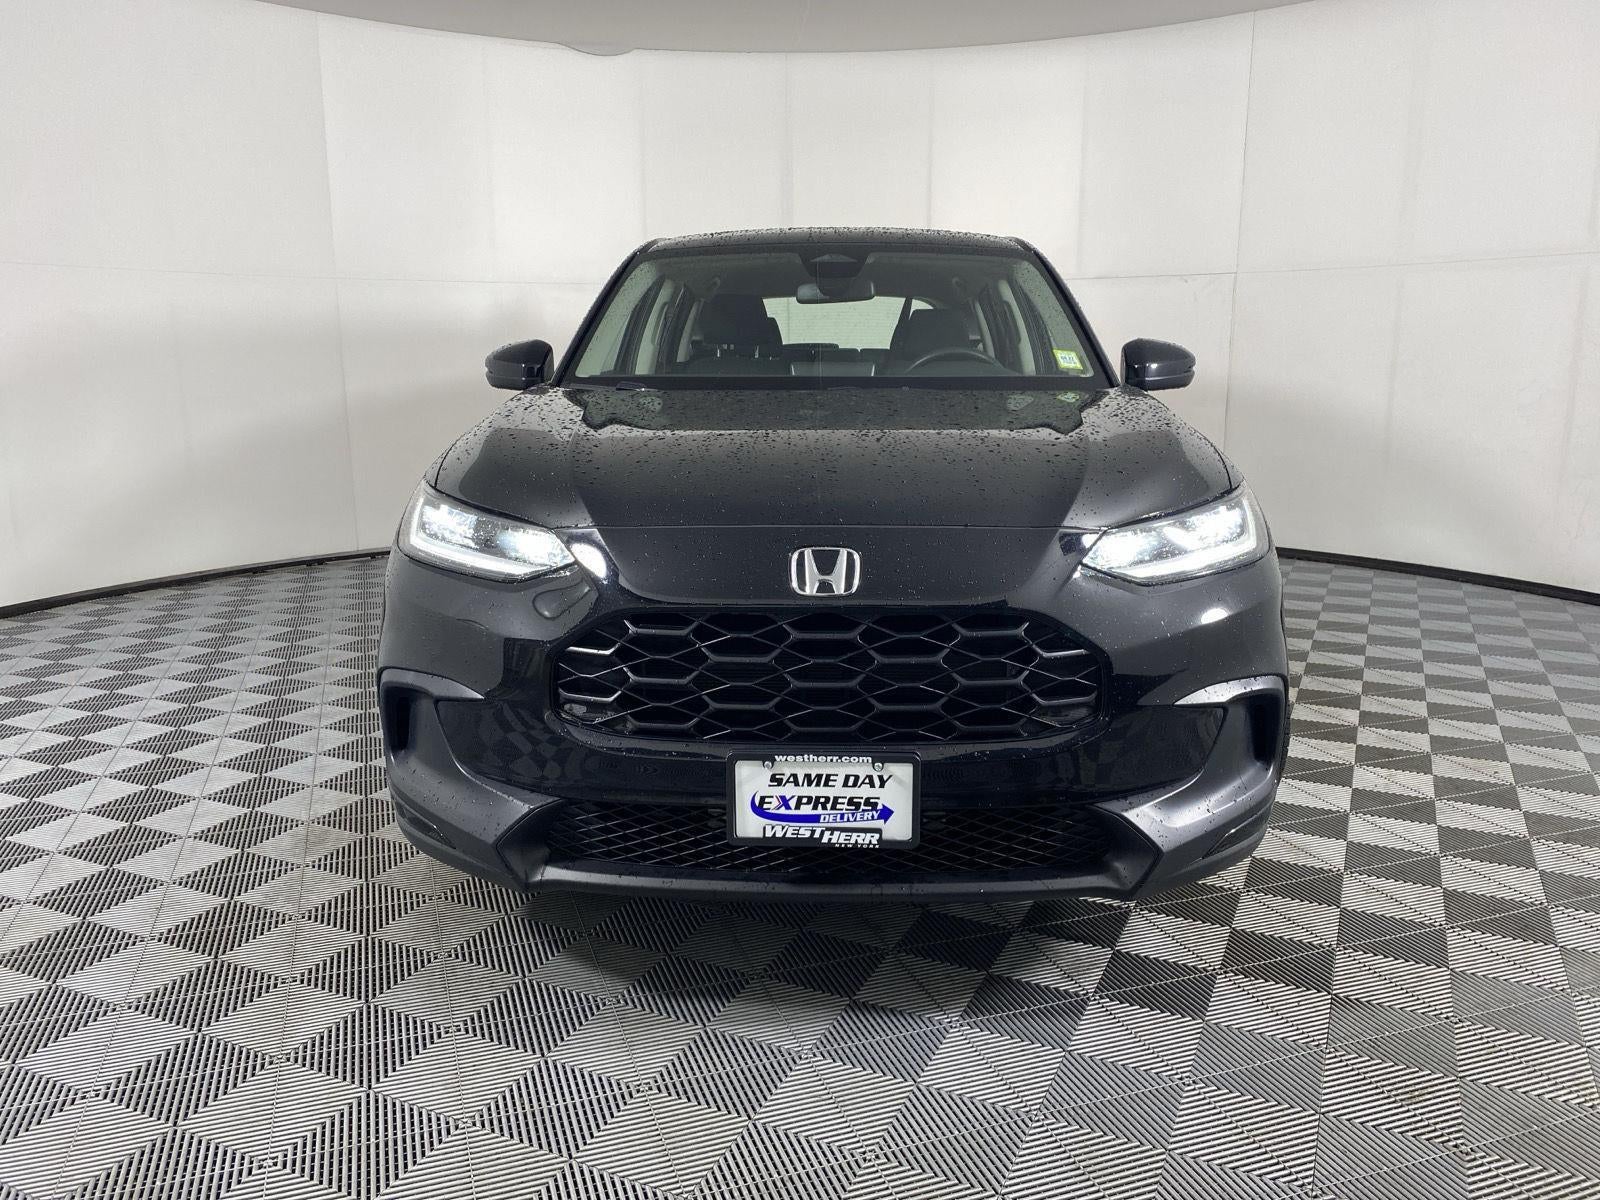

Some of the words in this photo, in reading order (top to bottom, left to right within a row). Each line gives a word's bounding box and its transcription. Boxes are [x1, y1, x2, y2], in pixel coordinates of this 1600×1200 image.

[774, 754, 873, 763] westherr.com
[768, 772, 839, 788] SAME
[841, 774, 894, 789] DAY
[757, 794, 881, 812] EXPRESS
[819, 810, 881, 823] DELIVERY
